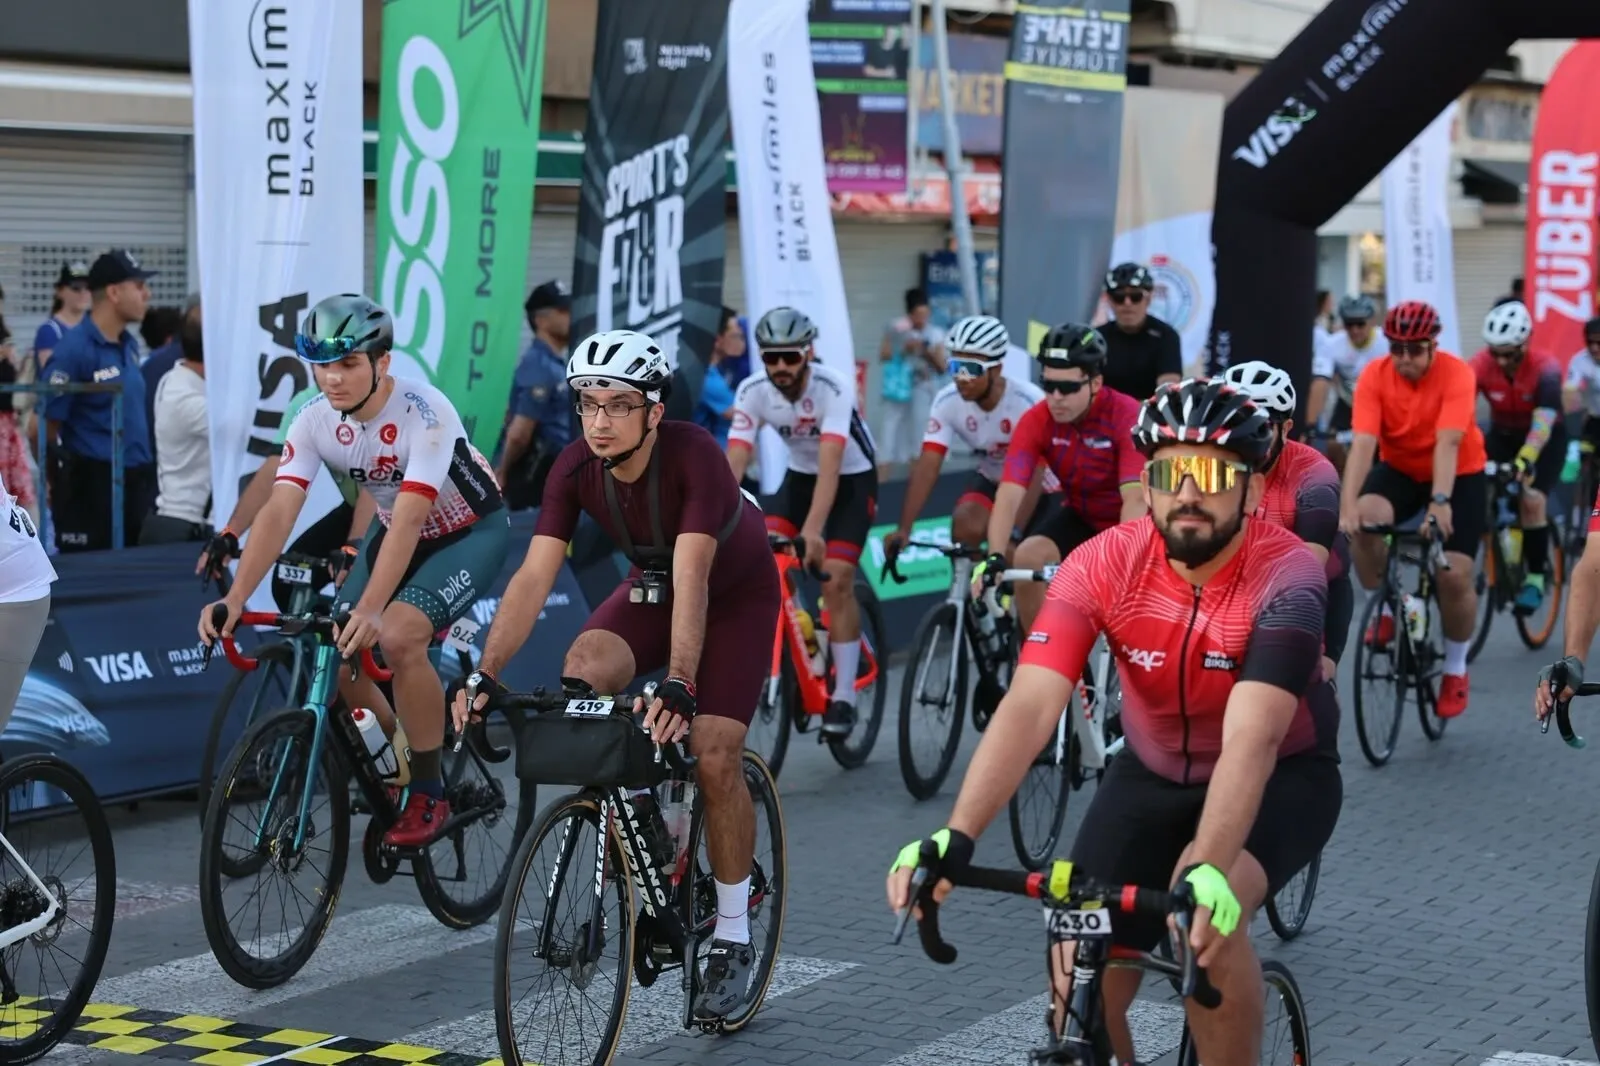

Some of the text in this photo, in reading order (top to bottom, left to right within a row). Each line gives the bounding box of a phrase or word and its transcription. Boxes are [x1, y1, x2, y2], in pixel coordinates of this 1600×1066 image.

[298, 80, 319, 196] BLACK
[475, 148, 501, 297] MORE
[788, 183, 811, 261] BLACK
[1535, 150, 1599, 323] ZÜBER
[467, 320, 489, 391] TO
[404, 391, 440, 430] ORBEA
[284, 567, 306, 580] 337
[438, 569, 472, 605] bike
[84, 650, 154, 684] VISA
[574, 700, 605, 713] 419
[595, 799, 608, 898] SALCANO
[617, 785, 667, 907] SALCANO
